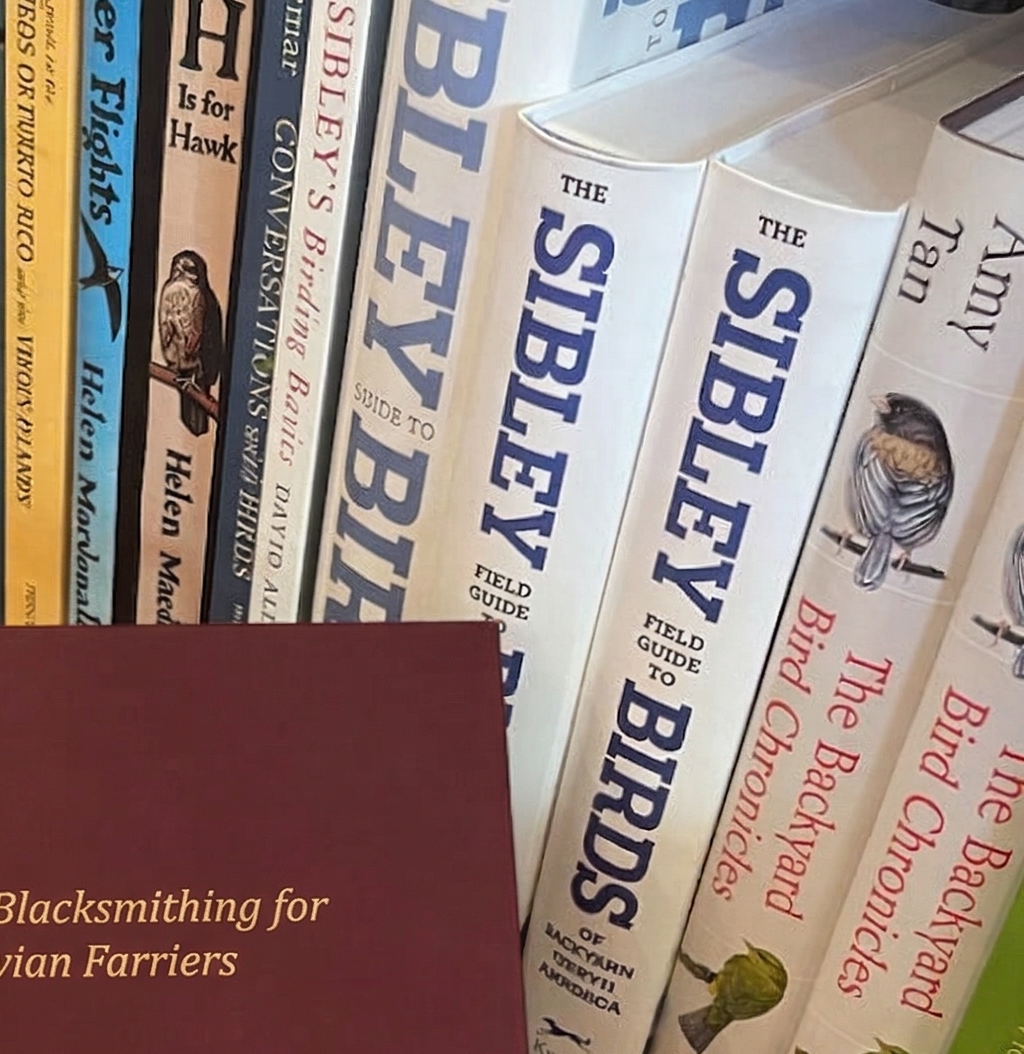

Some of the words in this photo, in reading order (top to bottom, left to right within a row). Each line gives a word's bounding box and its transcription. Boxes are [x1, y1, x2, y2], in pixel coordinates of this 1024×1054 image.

[178, 0, 246, 81] H
[178, 84, 196, 110] Is
[200, 89, 236, 122] for
[307, 0, 356, 213] SIBLEY'S
[81, 74, 126, 225] Flights
[168, 118, 238, 164] Hawk
[560, 173, 609, 204] THE
[758, 214, 808, 249] THE
[898, 209, 964, 304] Tan
[947, 214, 1024, 352] Amy
[78, 360, 106, 462] Helen
[407, 414, 436, 442] TO
[481, 206, 616, 571] SIBLEY
[652, 247, 812, 624] SIBLEY
[160, 447, 194, 537] Helen
[468, 585, 530, 622] GUIDE
[474, 563, 532, 598] FIELD
[637, 635, 702, 675] GUIDE
[643, 612, 705, 651] FIELD
[778, 594, 837, 694] Bird
[648, 662, 676, 687] TO
[826, 650, 893, 730] The
[919, 685, 990, 790] Bird
[571, 678, 693, 931] BIRDS
[711, 699, 802, 901] Chronicles
[764, 739, 861, 921] Backyard
[266, 887, 329, 932] for
[578, 926, 607, 946] OF
[837, 794, 946, 998] Chronicles
[900, 835, 1014, 1019] Backyard
[82, 944, 239, 979] Farriers
